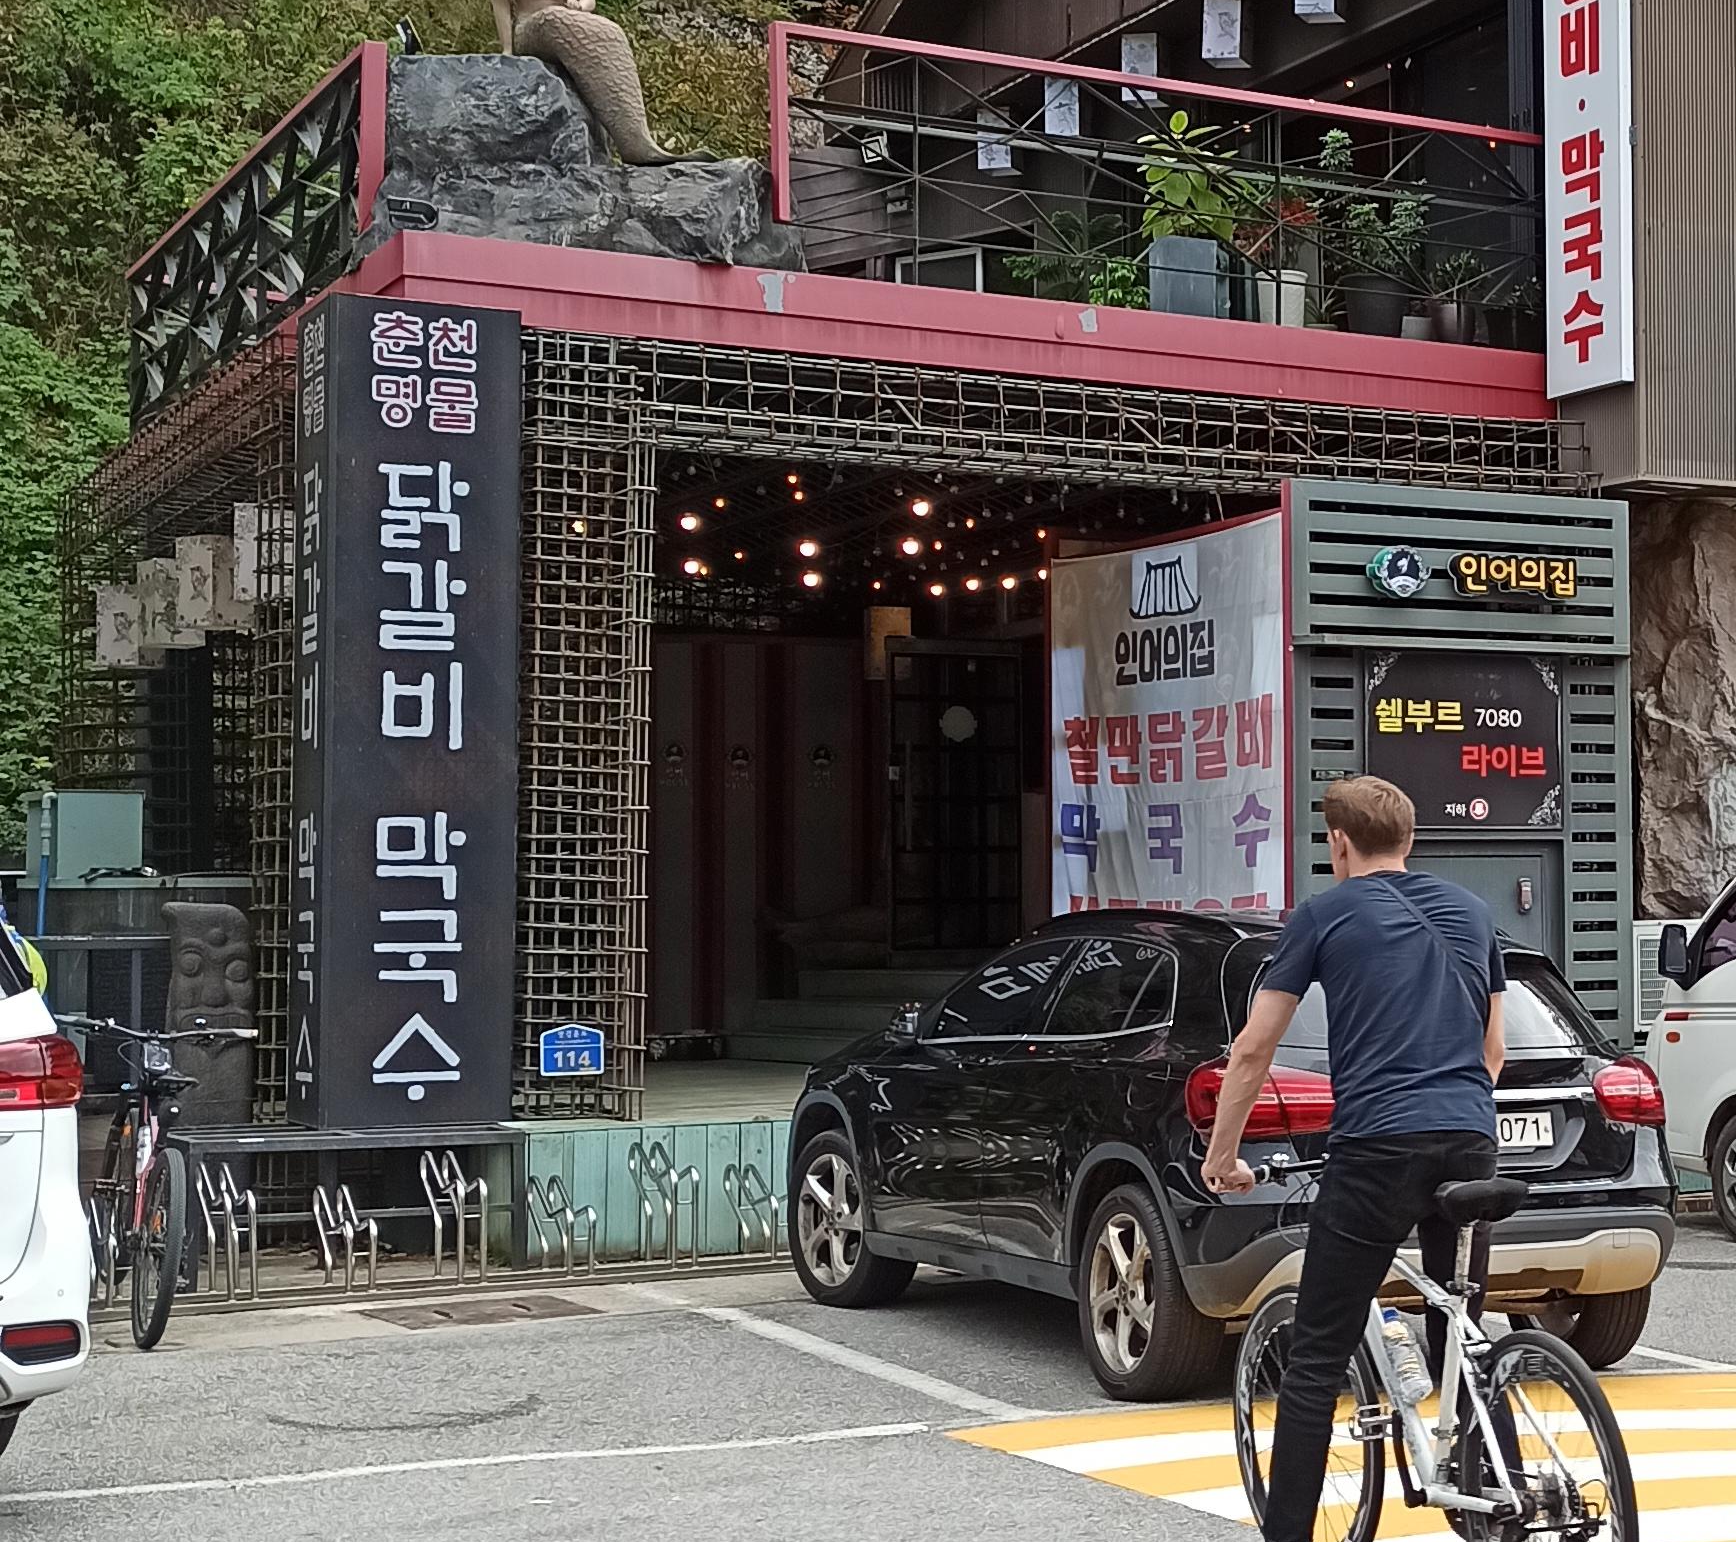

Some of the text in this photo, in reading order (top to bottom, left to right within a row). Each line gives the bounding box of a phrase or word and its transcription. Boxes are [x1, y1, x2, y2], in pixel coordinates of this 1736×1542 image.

[1562, 128, 1606, 363] 막국수
[371, 310, 479, 374] 춘천
[371, 374, 480, 436] 명물
[378, 460, 471, 751] 닭갈비
[1458, 553, 1578, 598] 인어의집
[1114, 618, 1216, 686] 인어의집
[1062, 692, 1274, 787] 철판닭갈비
[1375, 698, 1522, 733] 쉘부르 7080
[1462, 744, 1547, 778] 라이브
[371, 810, 468, 1102] 막국수
[553, 1050, 592, 1068] 114
[1500, 1117, 1542, 1142] 071
